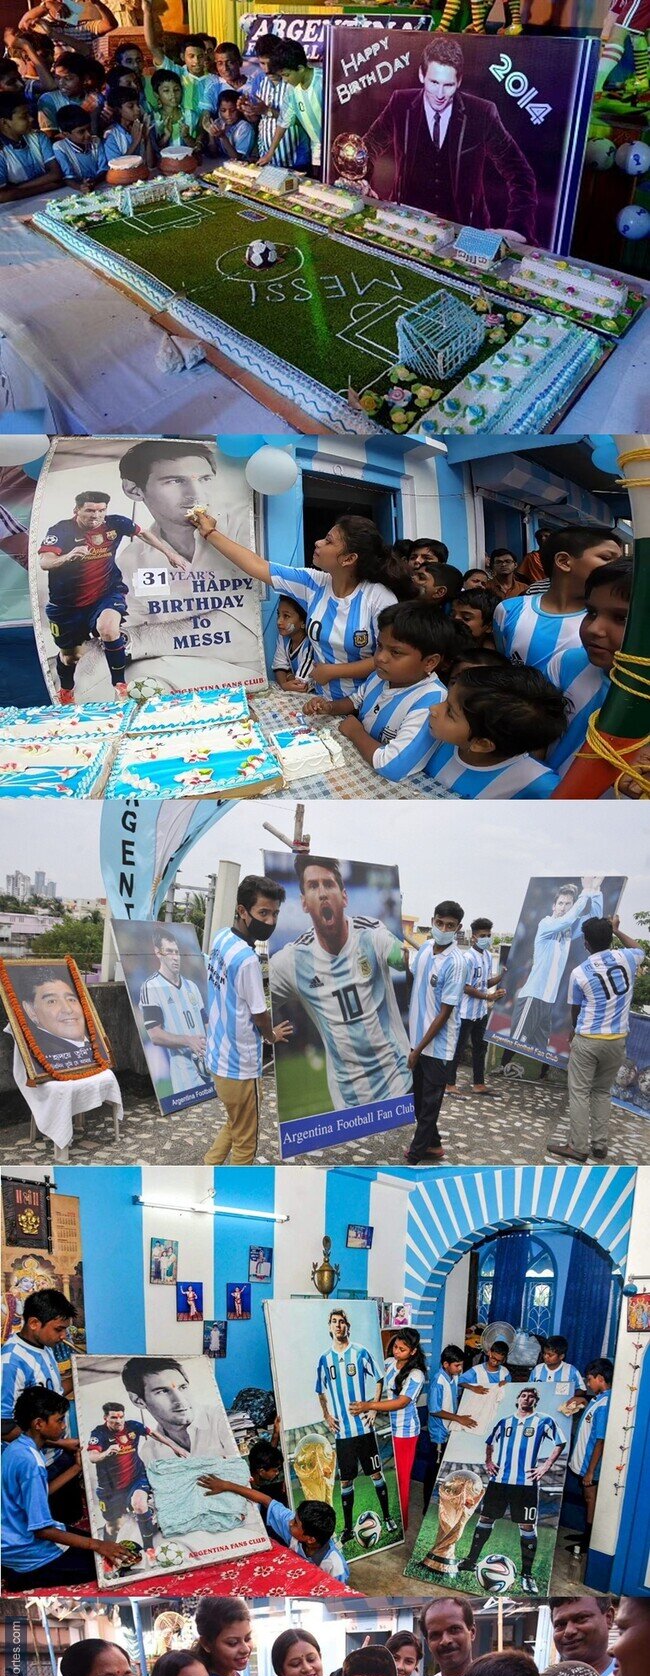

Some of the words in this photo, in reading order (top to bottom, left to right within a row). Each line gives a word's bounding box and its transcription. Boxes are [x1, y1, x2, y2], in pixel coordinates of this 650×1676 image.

[341, 36, 390, 77] HAPPY
[489, 53, 553, 125] 2014
[142, 571, 166, 585] 31
[170, 570, 215, 580] YEAR'S
[192, 578, 253, 593] HAPPY
[148, 595, 244, 614] BIRTHDAY
[173, 631, 231, 649] MESSI
[244, 678, 265, 686] CLUB
[593, 964, 630, 1000] 10
[332, 984, 364, 1022] 10
[183, 1010, 195, 1029] 10
[283, 1124, 334, 1144] Argentina
[336, 1112, 374, 1131] Football
[377, 1109, 393, 1121] Fan
[395, 1103, 415, 1116] Club
[370, 1454, 381, 1470] 10
[523, 1506, 537, 1521] 10
[188, 1545, 229, 1559] ARGENTINA
[230, 1540, 248, 1550] FANS
[248, 1536, 267, 1546] CLUB
